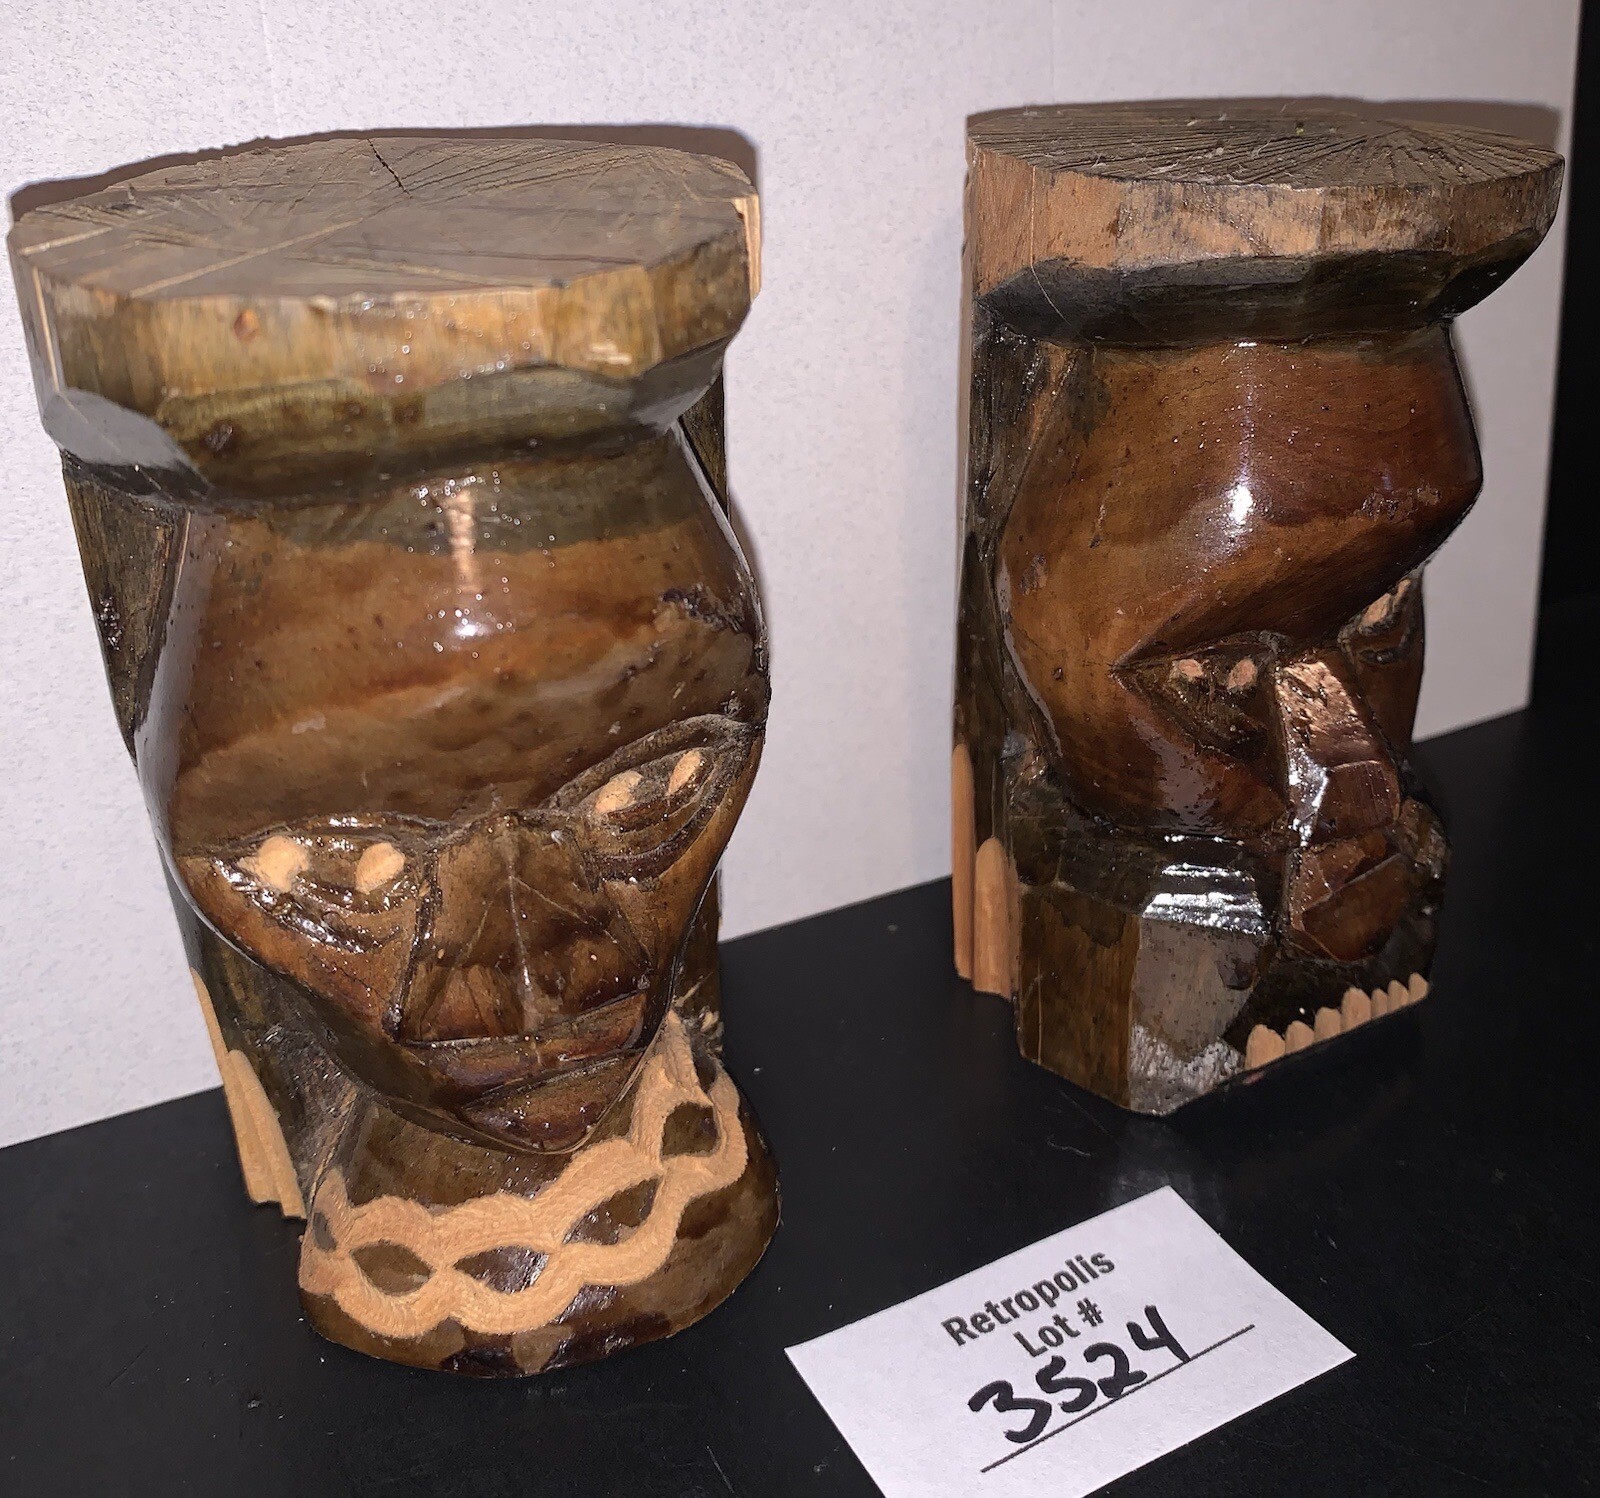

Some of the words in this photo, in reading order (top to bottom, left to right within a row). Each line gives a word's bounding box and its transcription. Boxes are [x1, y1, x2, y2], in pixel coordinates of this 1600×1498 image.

[942, 1251, 1115, 1346] Retropolis
[1013, 1315, 1080, 1358] Lot
[1078, 1298, 1104, 1327] #
[968, 1305, 1190, 1443] 3524
